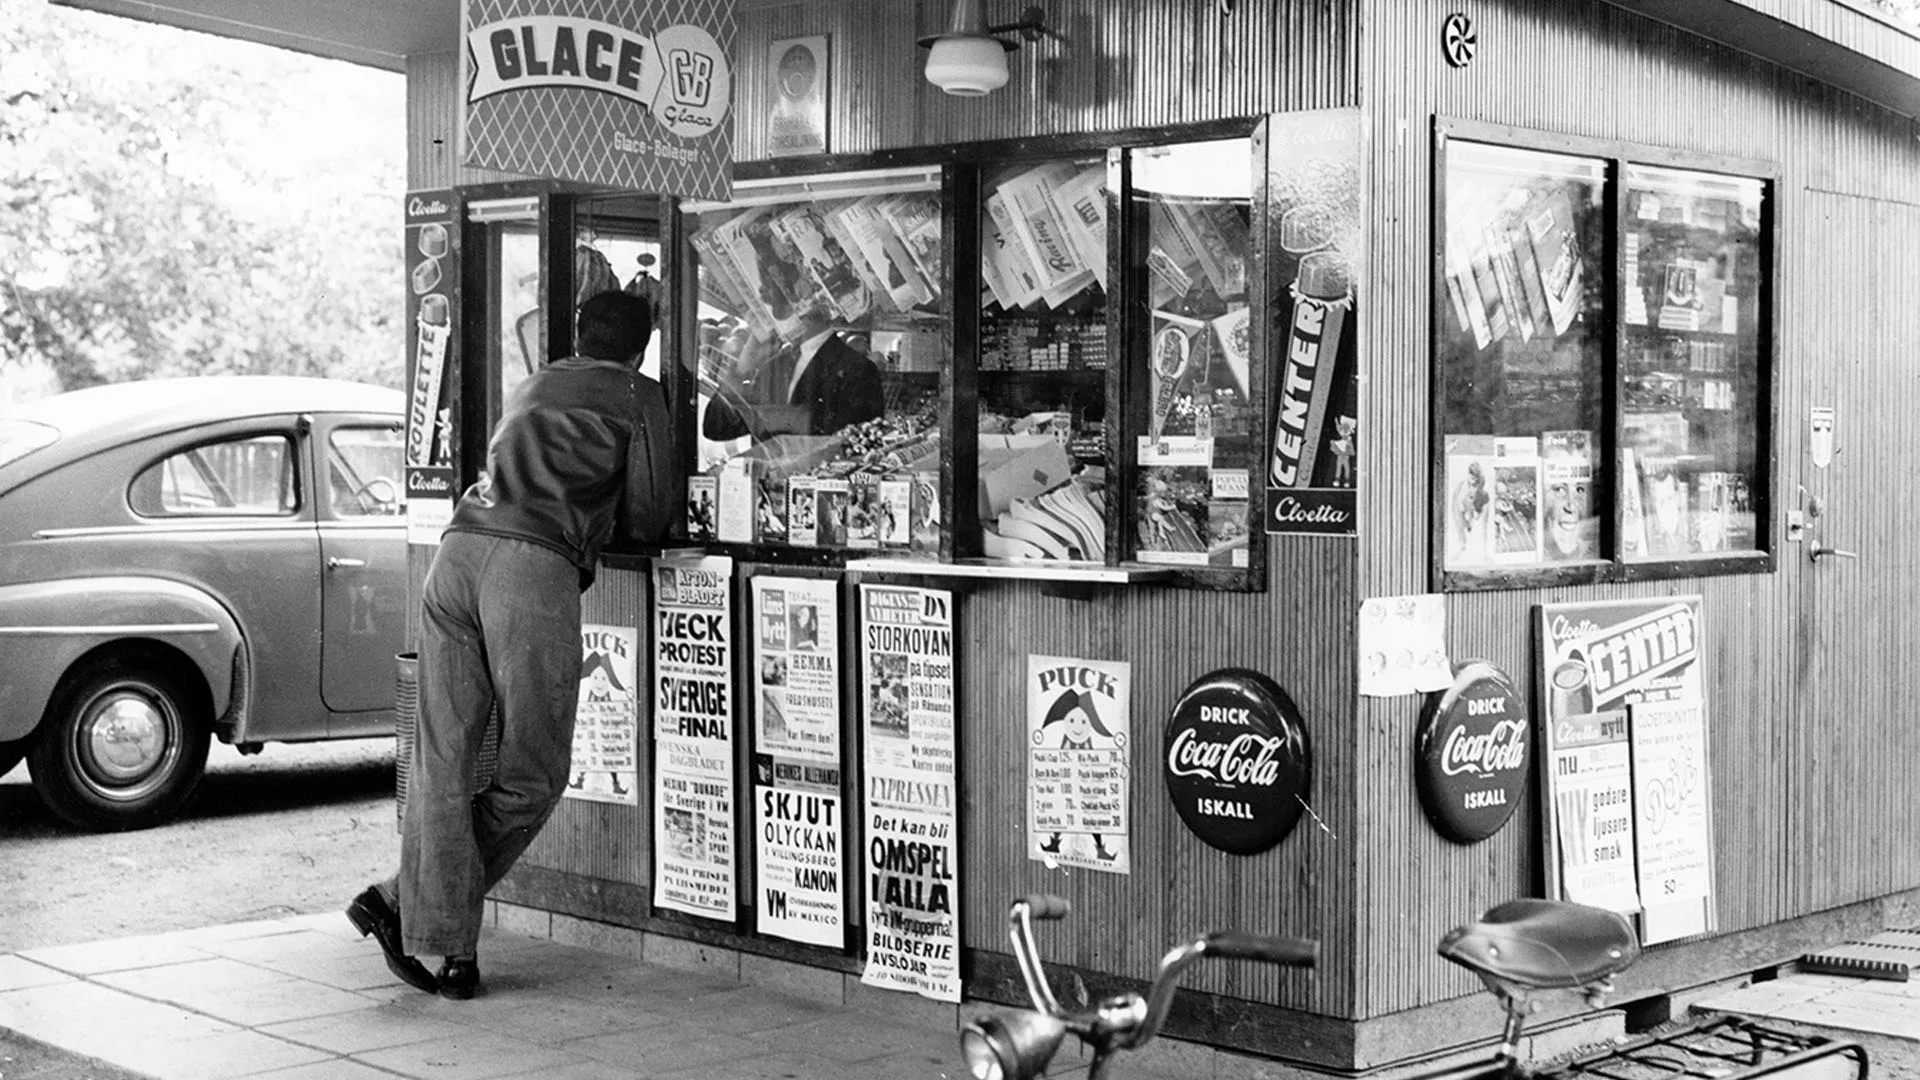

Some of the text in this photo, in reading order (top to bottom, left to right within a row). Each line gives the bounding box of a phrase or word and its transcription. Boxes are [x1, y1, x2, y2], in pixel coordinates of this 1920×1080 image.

[490, 26, 644, 91] GLACE
[669, 49, 714, 108] GB
[664, 107, 714, 129] Glace
[408, 196, 449, 217] Cloetta
[409, 328, 436, 466] ROULETTE
[1274, 300, 1327, 487] CENTER
[408, 470, 450, 492] Cloetta
[1275, 496, 1350, 524] Cloetta
[679, 589, 725, 606] BLADET
[924, 595, 947, 620] DN
[659, 611, 726, 643] TJECK
[1551, 614, 1601, 641] Cloetta
[585, 631, 629, 659] UCK
[868, 625, 951, 657] STORKOVAN
[1590, 610, 1695, 692] CENTER
[659, 642, 726, 667] PROTEST
[910, 660, 951, 682] på tipset
[1038, 665, 1119, 700] PUCK
[660, 676, 728, 717] SVERIGE
[910, 682, 951, 701] SENSATION
[1200, 705, 1250, 725] DRICK
[1467, 696, 1506, 716] DRICK
[678, 717, 728, 741] FINAL
[1556, 715, 1625, 743] Cloetta nytt
[659, 740, 702, 758] SVENSKA
[1168, 727, 1286, 787] Coca-Cola
[1441, 718, 1528, 776] Coca-Cola
[670, 755, 726, 772] DAGBLADET
[1558, 754, 1578, 777] nu
[676, 794, 707, 812] Sverige
[716, 801, 729, 813] VM
[870, 776, 952, 808] EXPRESSEN
[1463, 788, 1507, 809] ISKALL
[1592, 785, 1628, 812] godare
[764, 791, 836, 827] SKJUT
[1197, 797, 1254, 820] ISKALL
[765, 822, 837, 854] OLYCKAN
[873, 814, 949, 840] Det kan bli
[1593, 815, 1628, 838] ljusare
[772, 850, 837, 868] VILLINGSBERG
[870, 836, 953, 880] OMSPEL
[1593, 839, 1622, 863] smak
[692, 868, 730, 884] PRISER
[794, 866, 838, 894] KANON
[766, 888, 787, 920] VM
[870, 872, 951, 915] I ALLA
[801, 911, 838, 926] MEXICO
[872, 932, 953, 961] BILDSERIE
[872, 951, 928, 976] AVSLÖJAR
